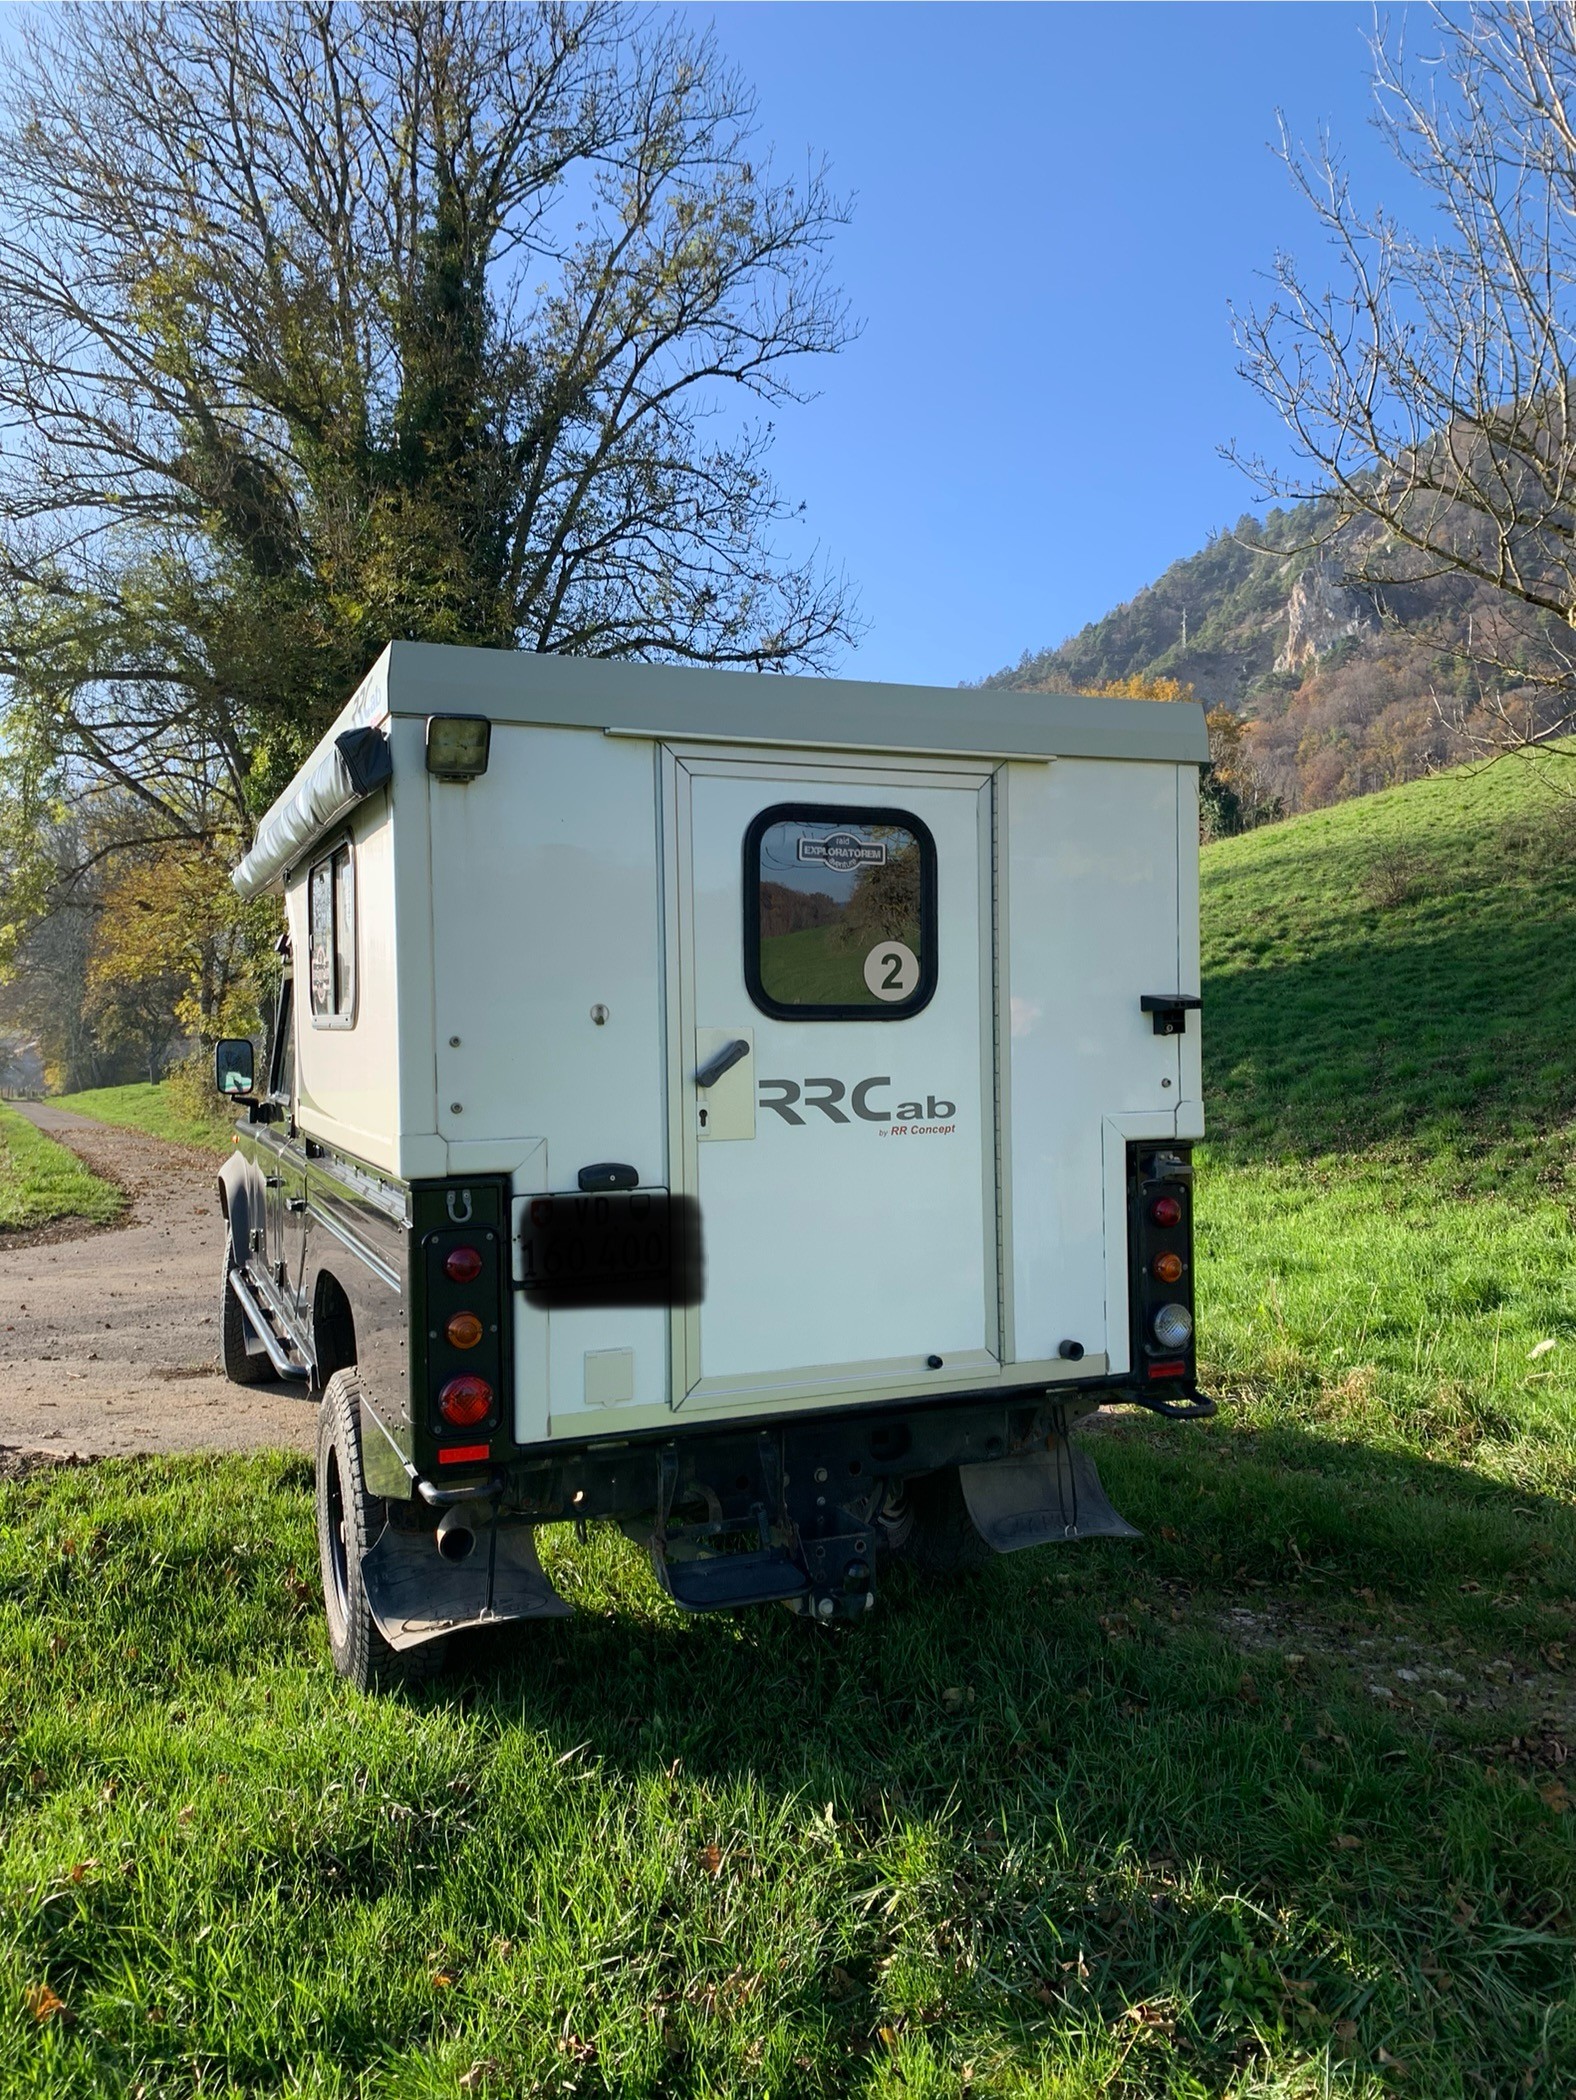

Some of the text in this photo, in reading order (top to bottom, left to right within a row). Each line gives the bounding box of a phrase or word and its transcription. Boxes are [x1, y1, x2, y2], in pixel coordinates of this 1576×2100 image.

[836, 837, 850, 846] raid
[803, 845, 882, 859] EXPLORATOREM
[828, 857, 858, 869] aventure
[880, 953, 904, 990] 2
[758, 1076, 957, 1126] RRCab
[878, 1124, 956, 1138] by RR Concept
